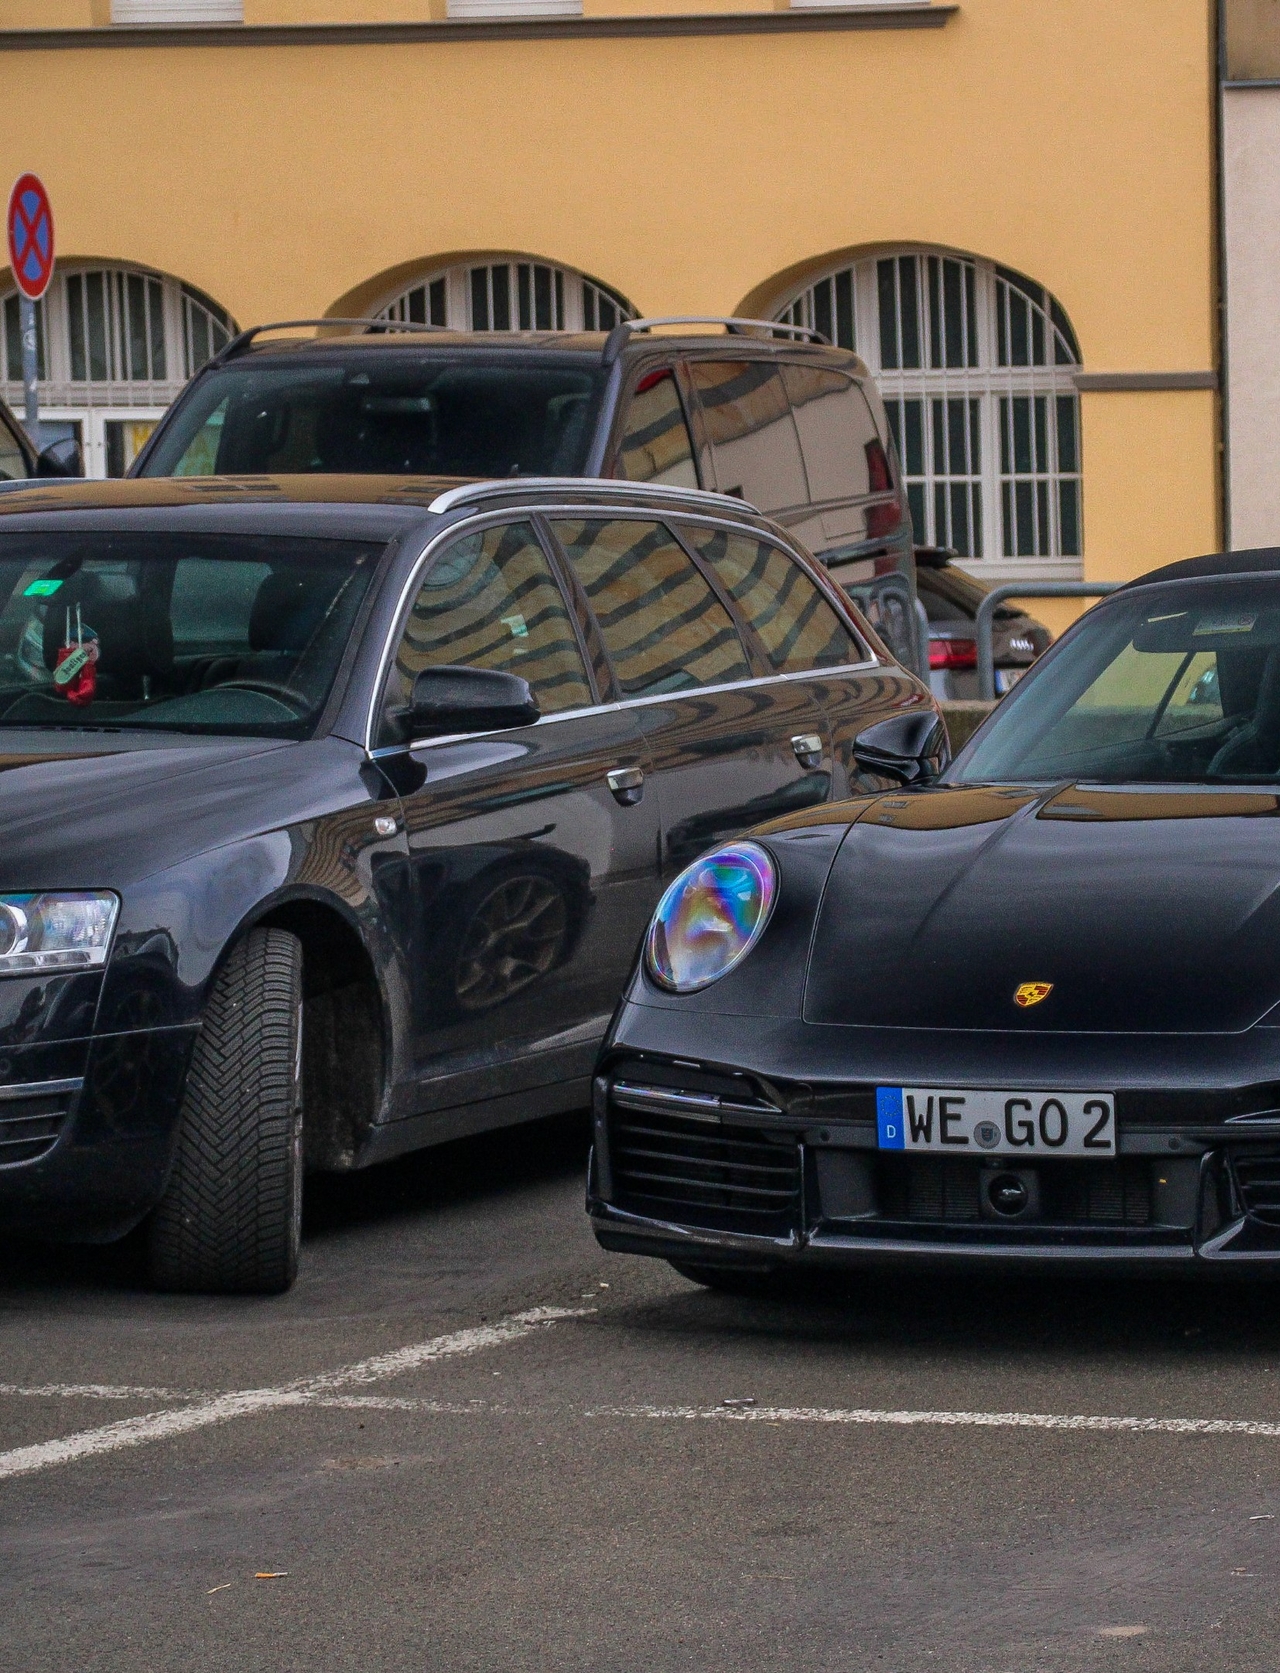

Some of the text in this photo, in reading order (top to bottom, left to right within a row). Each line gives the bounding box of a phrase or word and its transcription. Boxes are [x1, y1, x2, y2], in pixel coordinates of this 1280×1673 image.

[886, 1095, 1112, 1148] D WE GO 2
